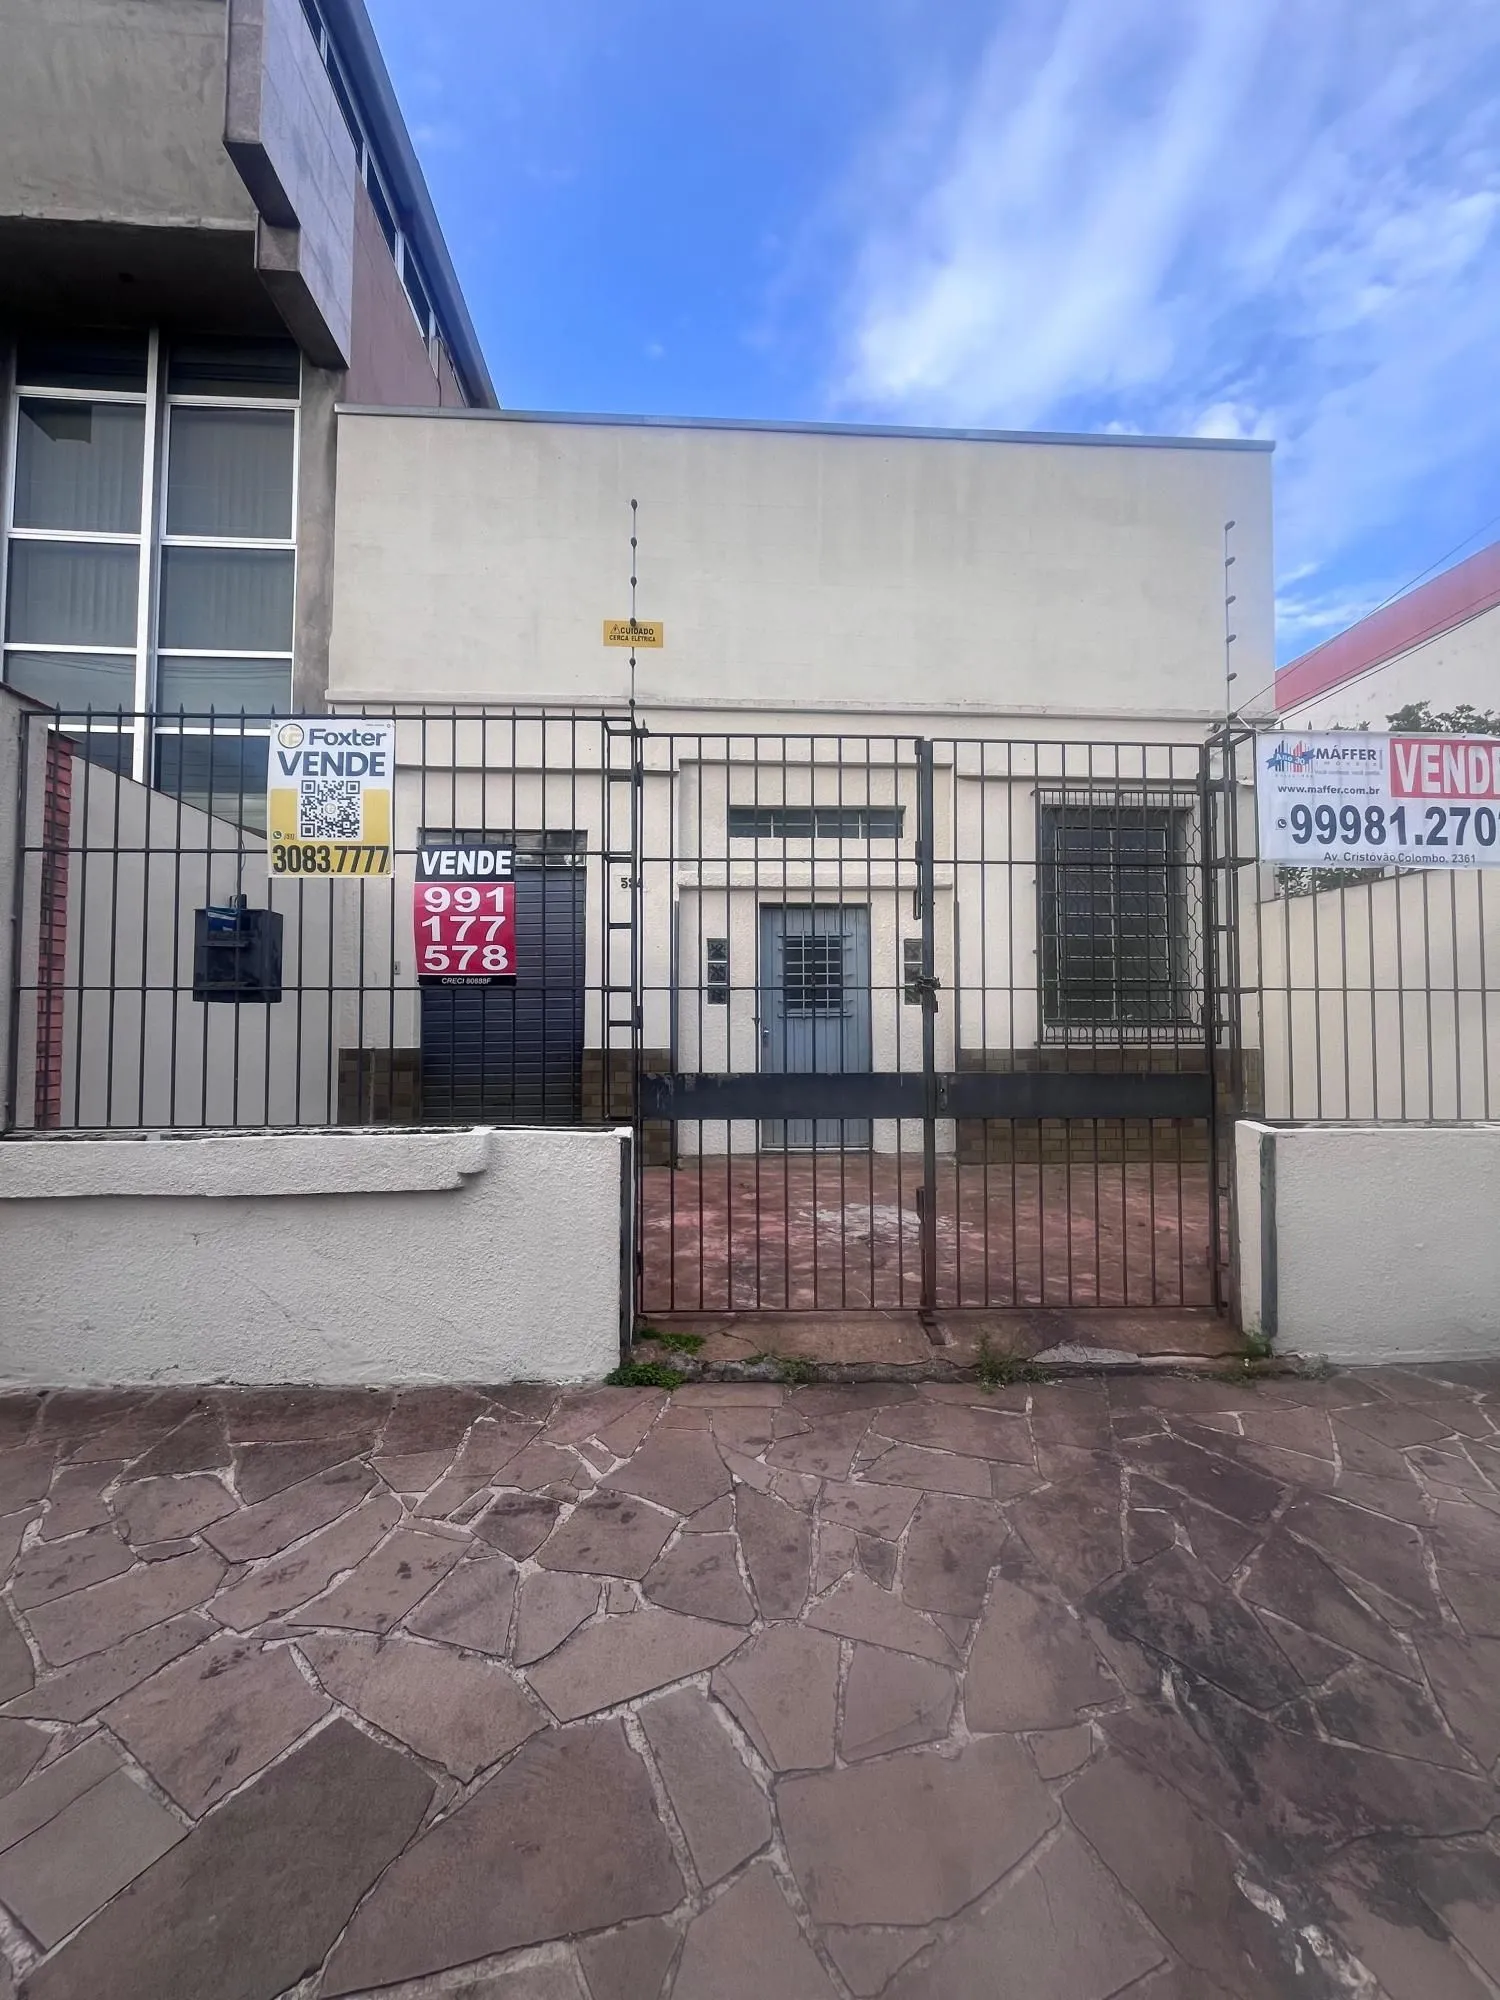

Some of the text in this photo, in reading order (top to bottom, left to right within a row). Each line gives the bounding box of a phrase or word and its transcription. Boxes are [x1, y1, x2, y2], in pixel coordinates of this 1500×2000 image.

[620, 627, 654, 635] CUIDADO
[309, 728, 387, 746] Foxter
[277, 750, 386, 776] VENDE
[1316, 744, 1377, 760] MÁFFER
[1277, 785, 1380, 795] www.maffer.com.br
[1290, 804, 1500, 847] 99981.270
[272, 844, 390, 872] 3083.7777
[422, 851, 512, 876] VENDE
[1324, 851, 1340, 862] Av.
[1344, 852, 1396, 862] Cristóvão
[1452, 854, 1476, 863] 2361
[424, 886, 505, 913] 991
[422, 916, 506, 942] 177
[424, 946, 508, 971] 578
